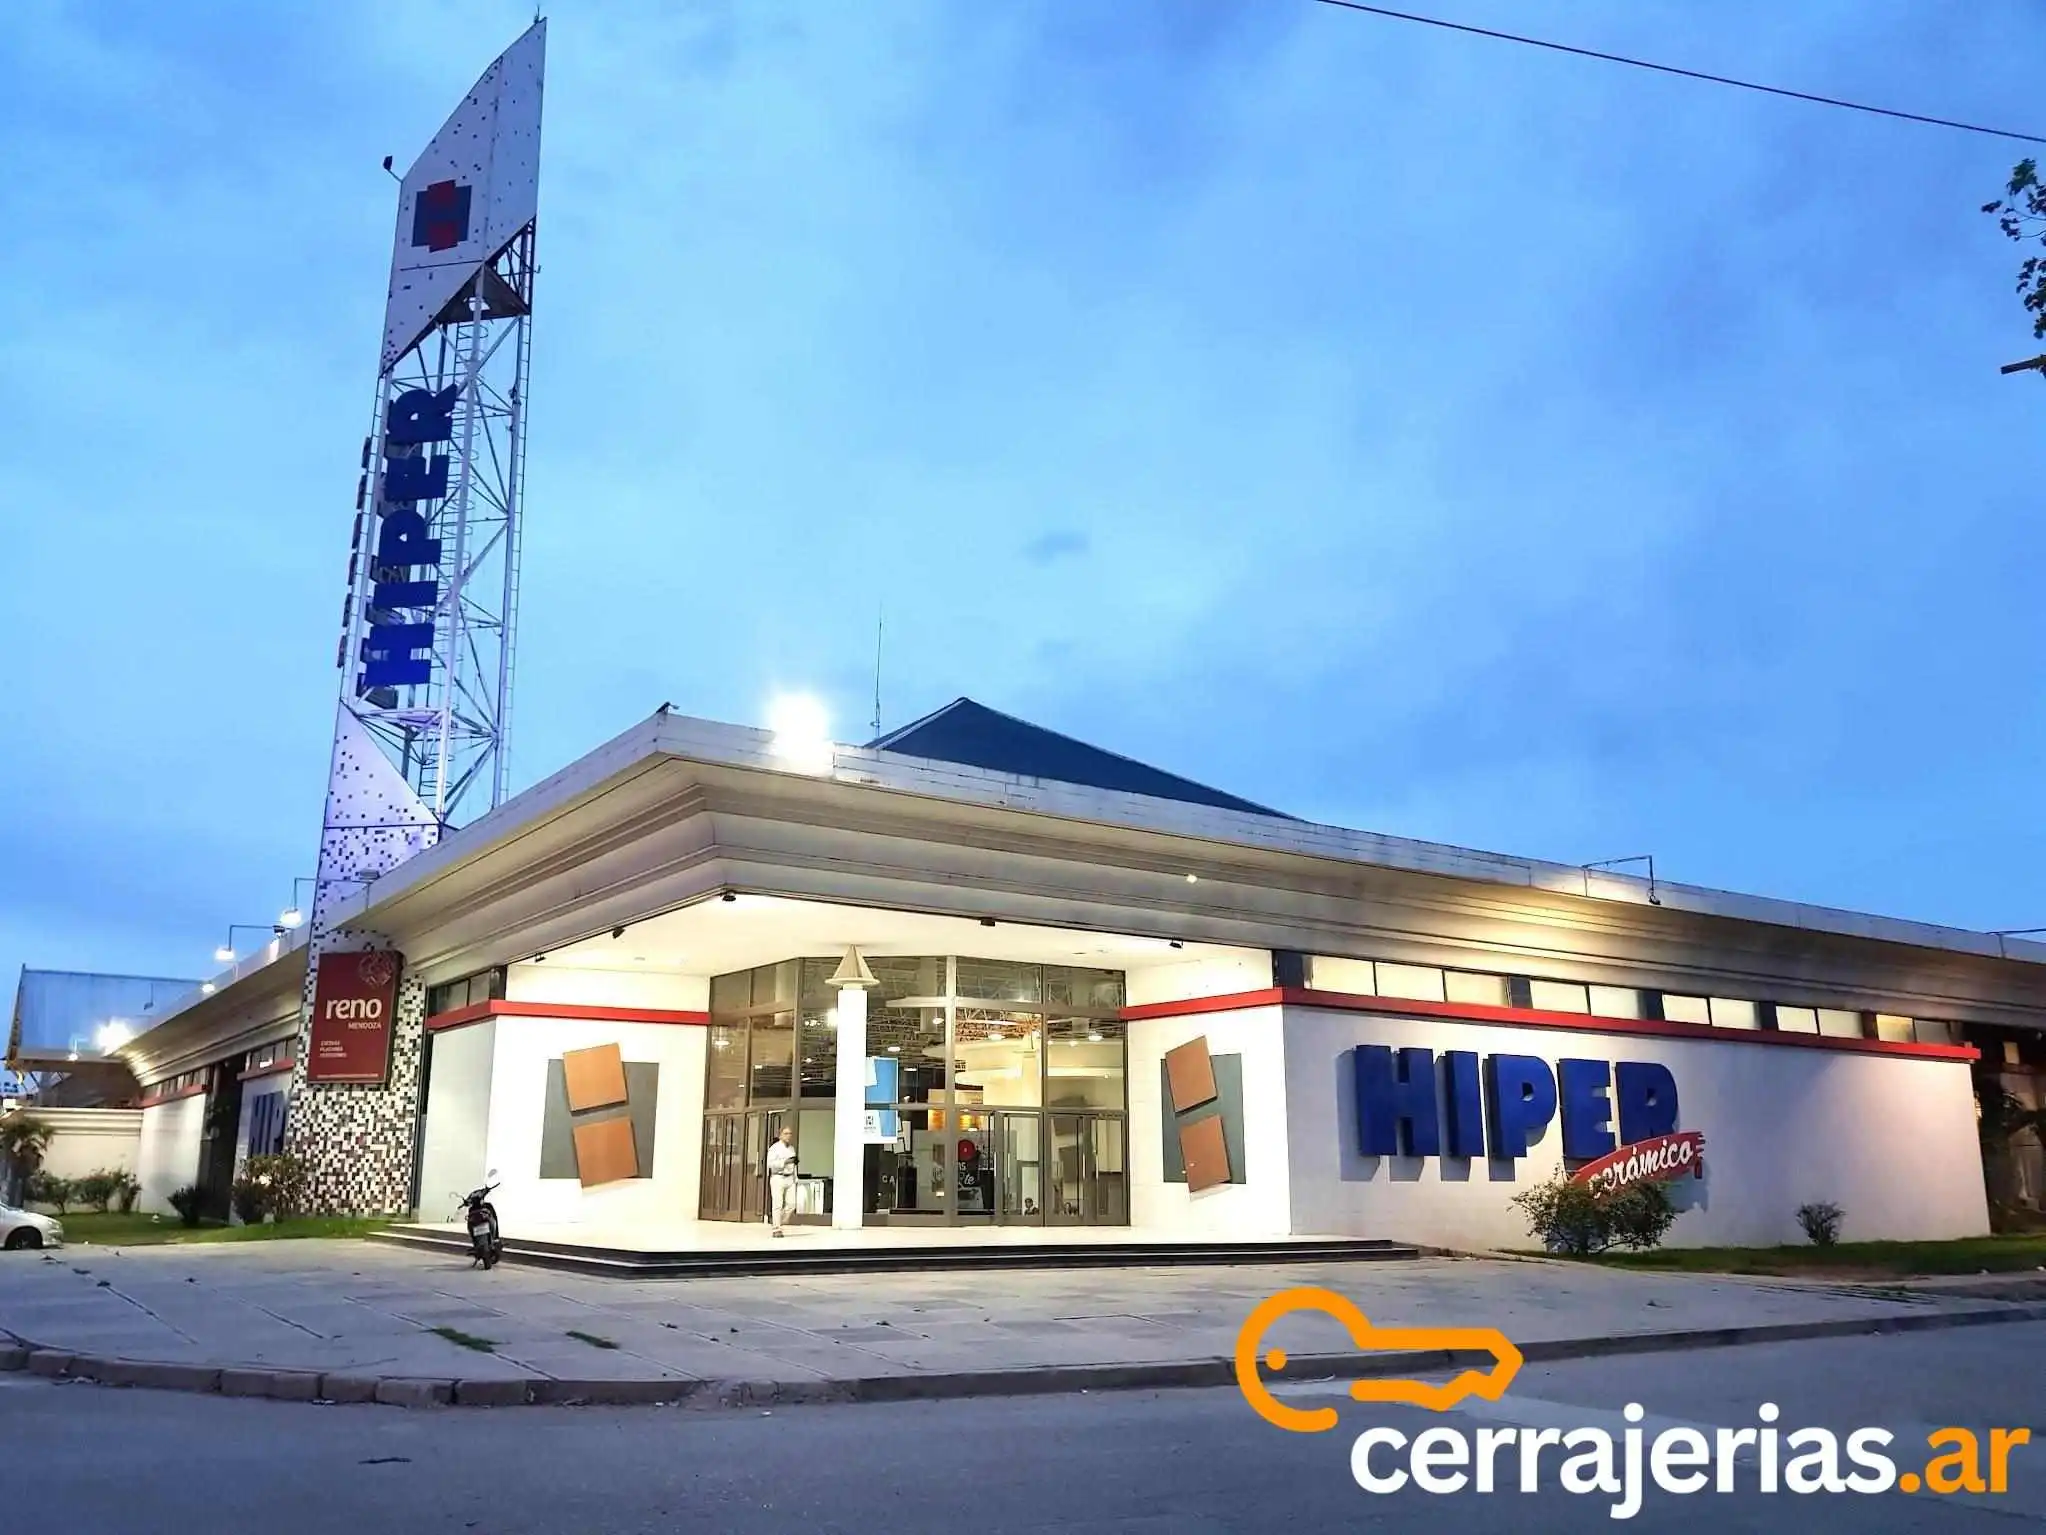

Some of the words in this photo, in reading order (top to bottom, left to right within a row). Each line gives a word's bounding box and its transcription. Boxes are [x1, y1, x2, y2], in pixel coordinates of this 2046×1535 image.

[363, 384, 457, 686] HIPER
[326, 998, 382, 1019] reno
[348, 1022, 382, 1030] MENDOZA
[1355, 1044, 1678, 1159] HIPER
